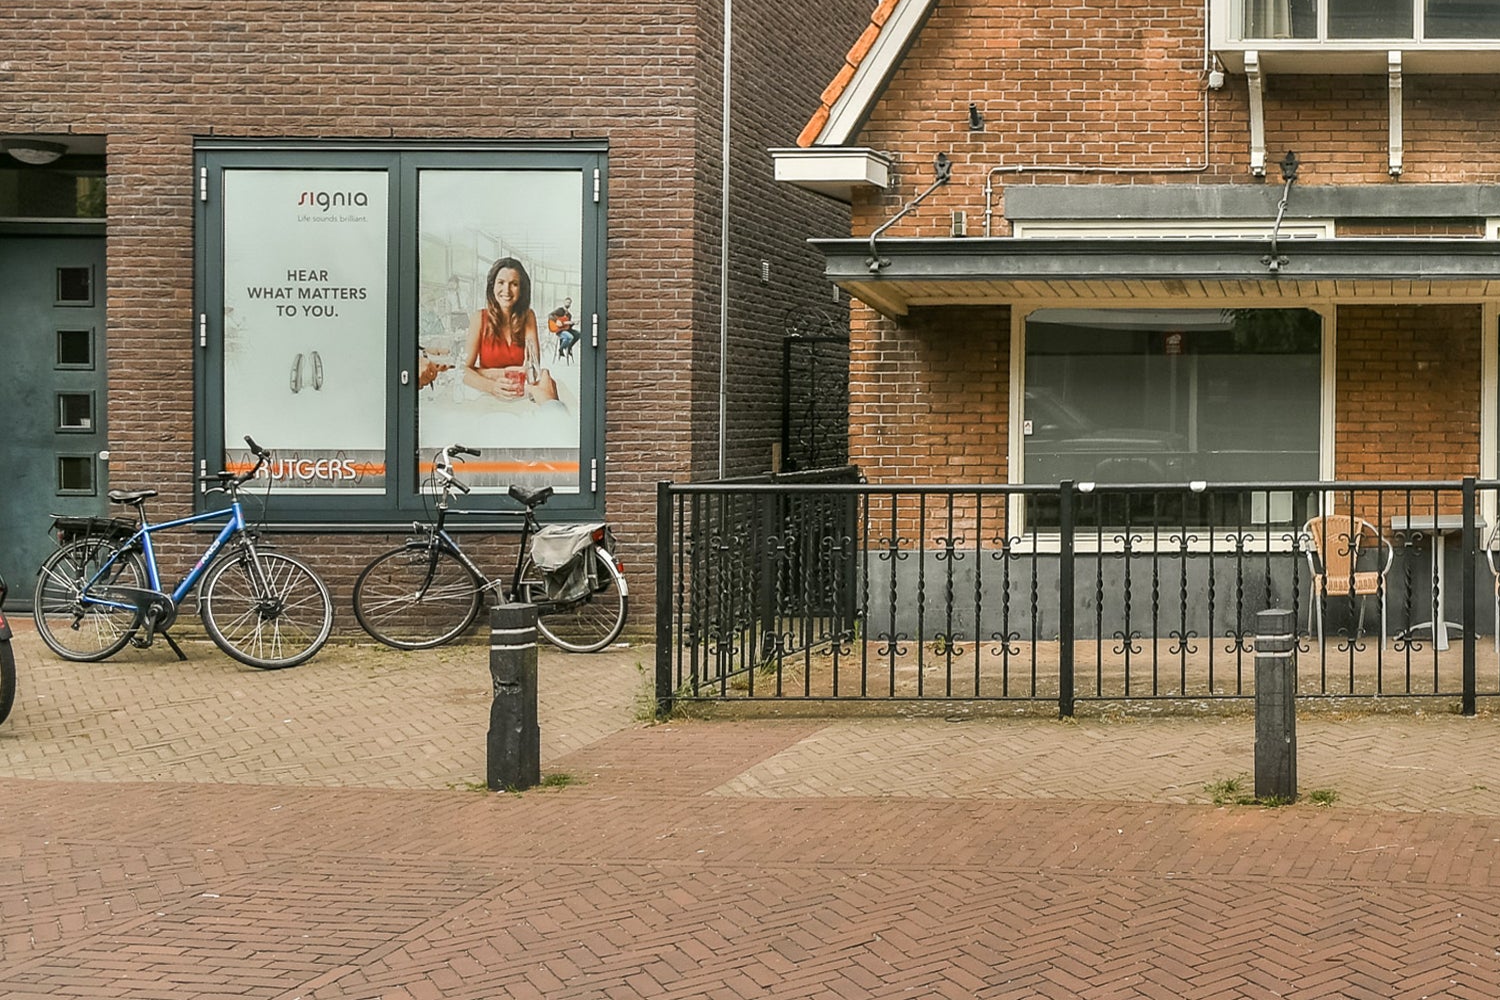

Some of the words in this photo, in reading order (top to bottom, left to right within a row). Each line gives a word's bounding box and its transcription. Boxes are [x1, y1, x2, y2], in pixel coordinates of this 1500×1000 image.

[298, 192, 368, 212] signia
[287, 269, 329, 282] HEAR
[247, 287, 293, 300] WHAT
[298, 287, 367, 300] MATTERS
[276, 305, 297, 317] TO
[302, 305, 338, 317] YOU.
[255, 459, 357, 480] RUTGERS
